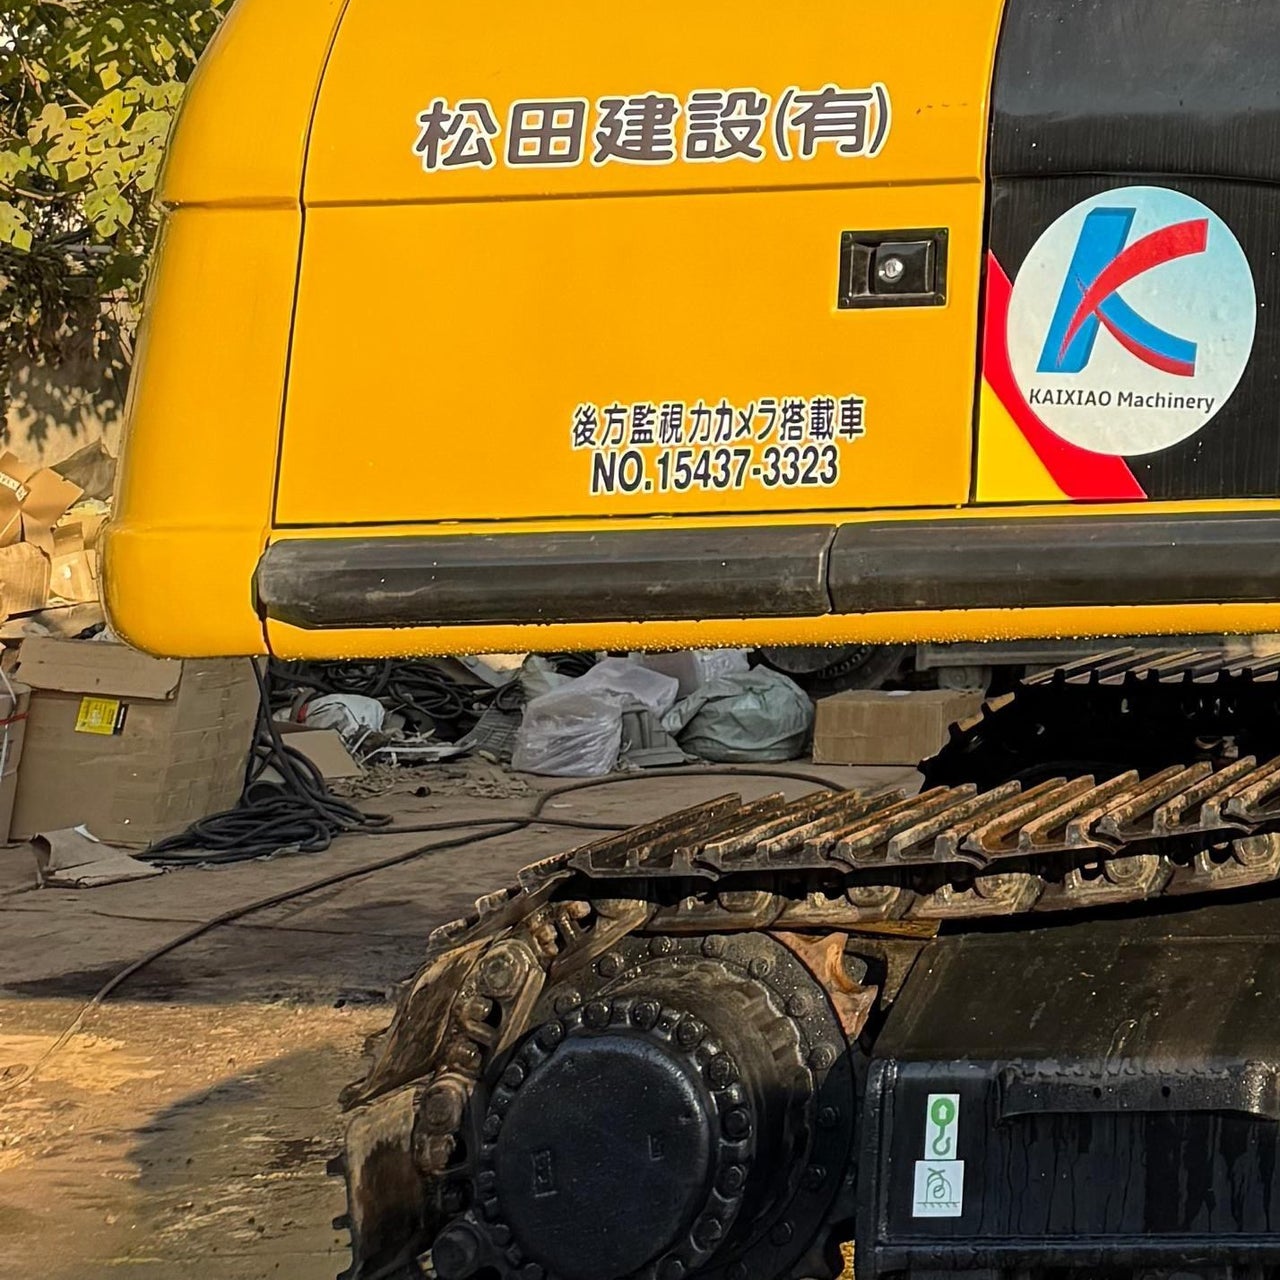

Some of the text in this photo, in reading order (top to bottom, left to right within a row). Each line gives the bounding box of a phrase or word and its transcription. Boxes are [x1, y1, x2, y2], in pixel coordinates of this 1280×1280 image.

[416, 85, 890, 169] 松田建設(有)
[1029, 388, 1215, 414] KAIXIAO Machinery
[591, 444, 838, 493] NO.15437-3323
